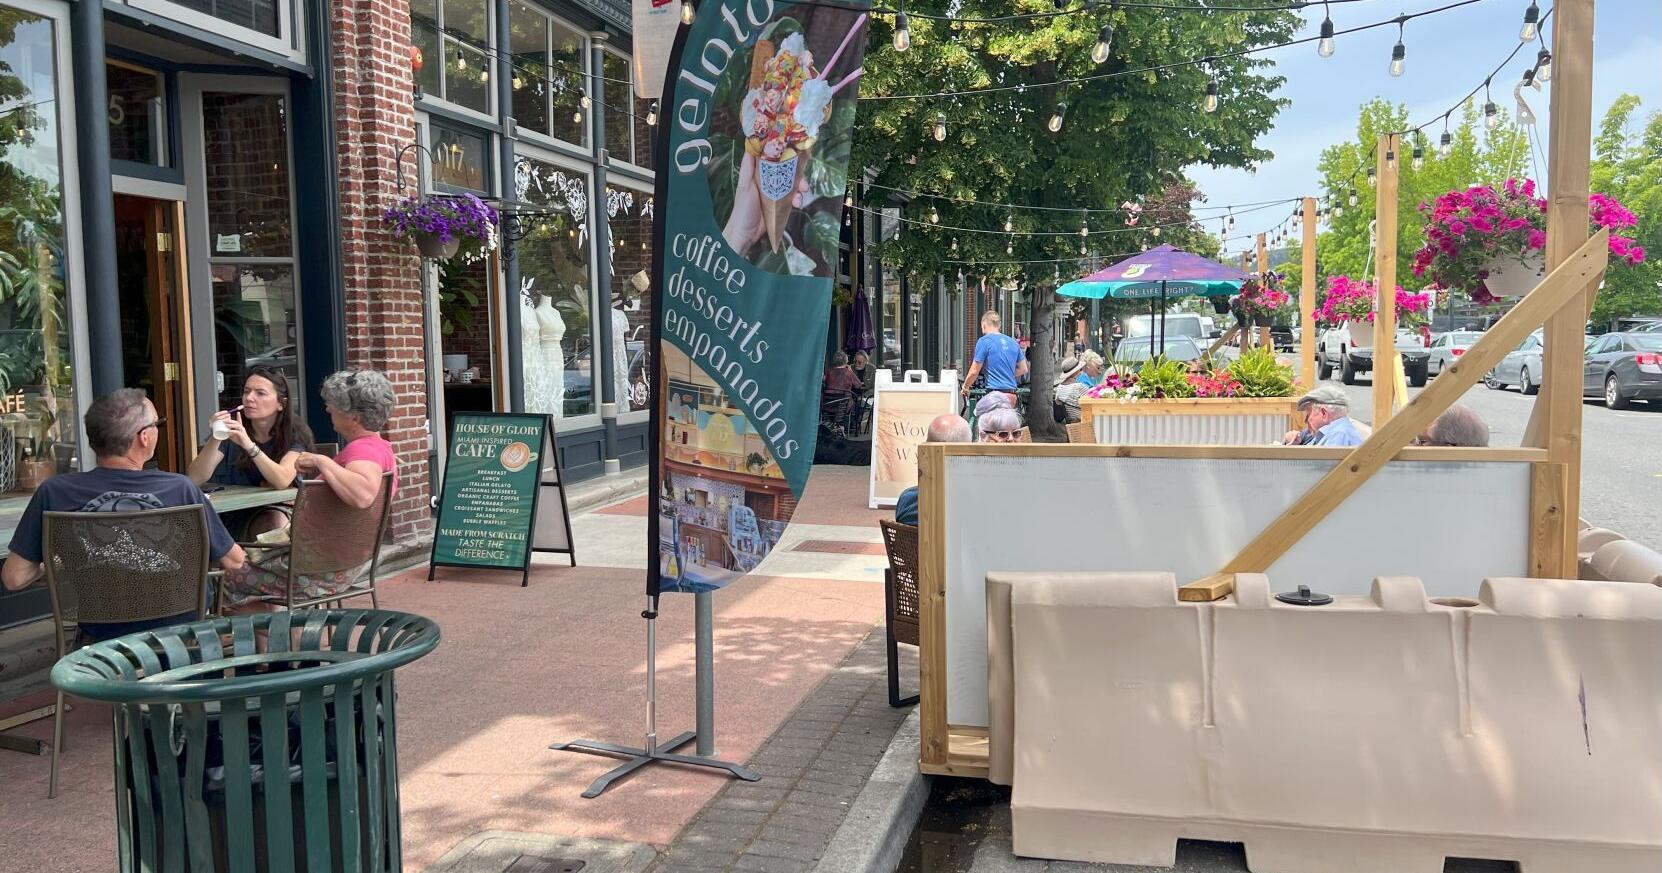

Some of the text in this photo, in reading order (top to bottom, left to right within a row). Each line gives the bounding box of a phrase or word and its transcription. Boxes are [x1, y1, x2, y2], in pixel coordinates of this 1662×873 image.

[675, 0, 775, 173] gelato
[672, 232, 746, 294] coffee
[668, 266, 769, 364] desserts
[664, 308, 800, 460] empanadas
[455, 423, 541, 436] HOUSE OF GLORY
[455, 443, 496, 458] CAFE
[441, 528, 525, 540] MADE FROM SCRATCH
[458, 538, 504, 549] TASTE THE
